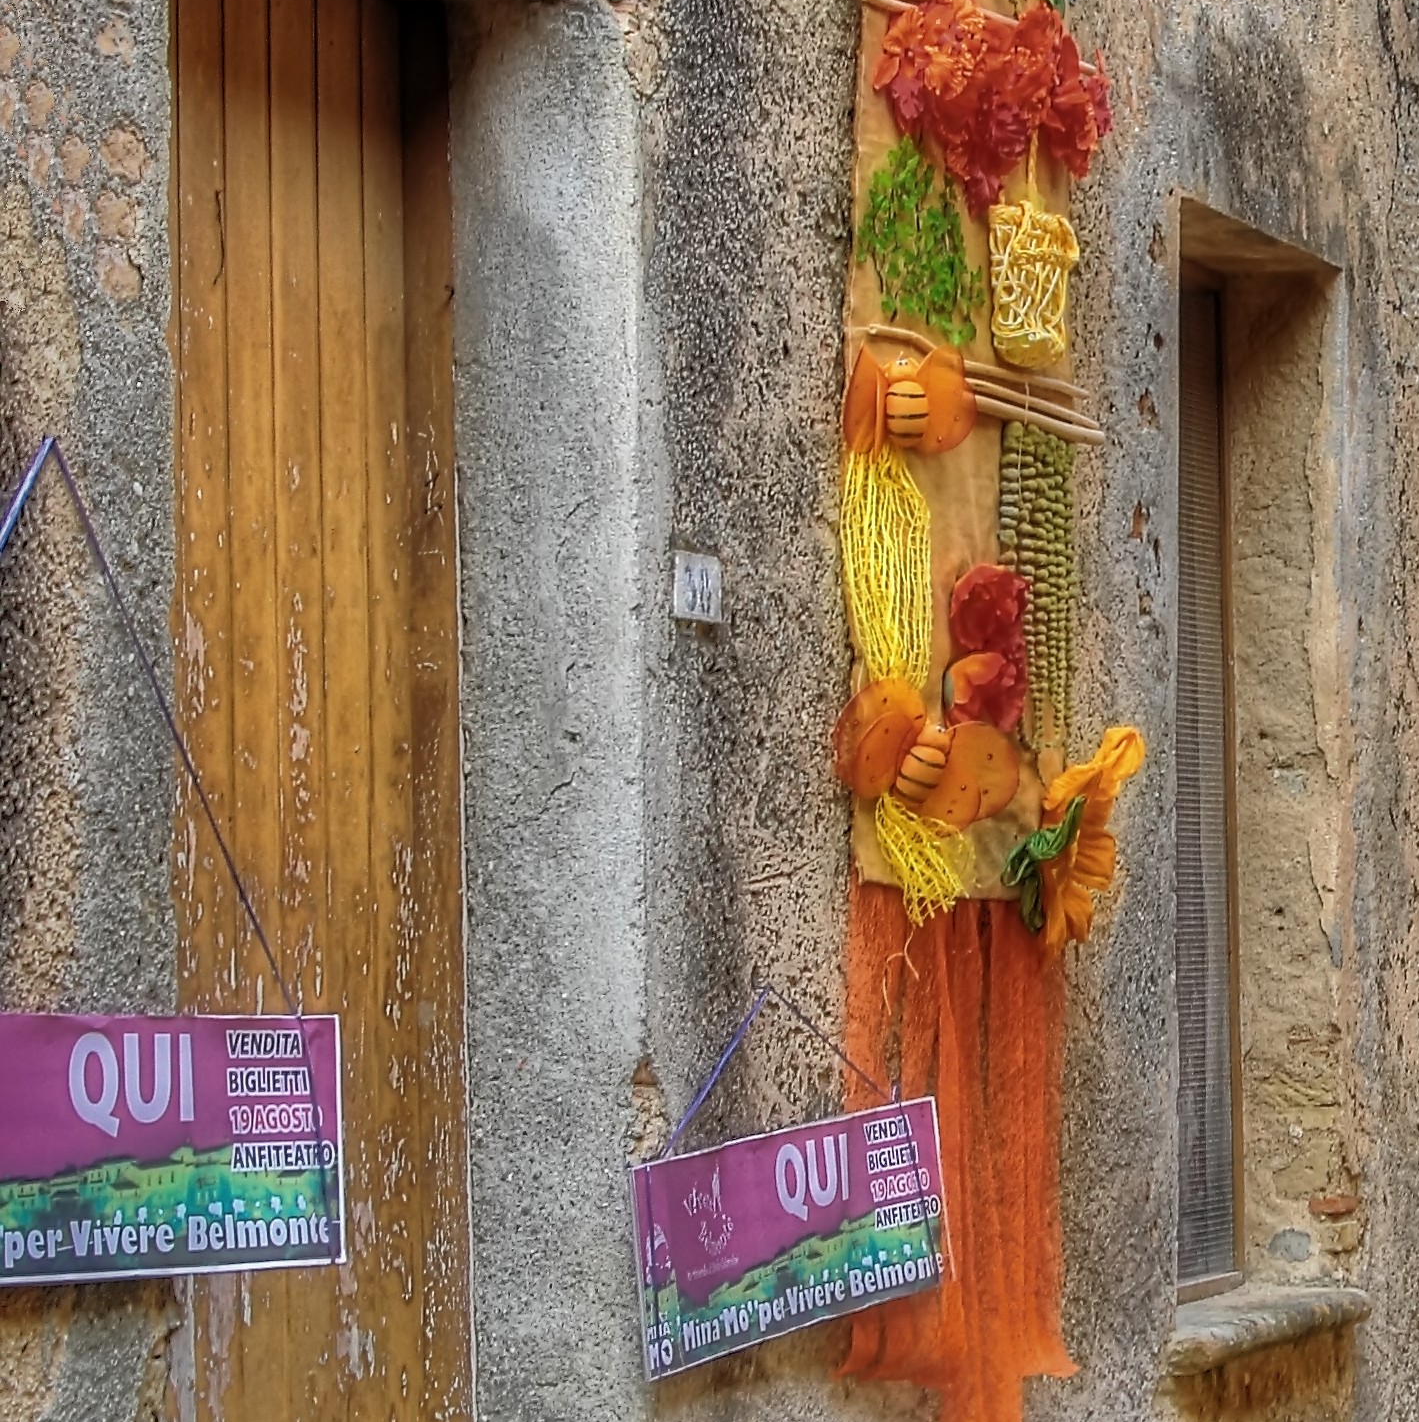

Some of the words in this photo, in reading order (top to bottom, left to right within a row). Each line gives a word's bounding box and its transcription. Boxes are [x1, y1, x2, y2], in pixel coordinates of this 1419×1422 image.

[226, 1030, 302, 1058] VENDITA
[69, 1033, 194, 1138] QUI
[227, 1067, 310, 1096] BIGLIETTI
[229, 1105, 252, 1134] 19
[253, 1104, 323, 1133] AGOST
[863, 1114, 912, 1145] VEND
[231, 1140, 335, 1172] ANFITEATRO
[867, 1141, 918, 1174] BIGLIE
[775, 1132, 849, 1222] QUI
[870, 1178, 886, 1202] 19
[887, 1168, 929, 1199] AGOO
[875, 1194, 941, 1231] ANFITERO
[5, 1229, 63, 1268] per
[70, 1220, 174, 1258] Vivere
[188, 1213, 330, 1251] Belmonte
[758, 1296, 785, 1332] per
[785, 1278, 845, 1316] Vivere
